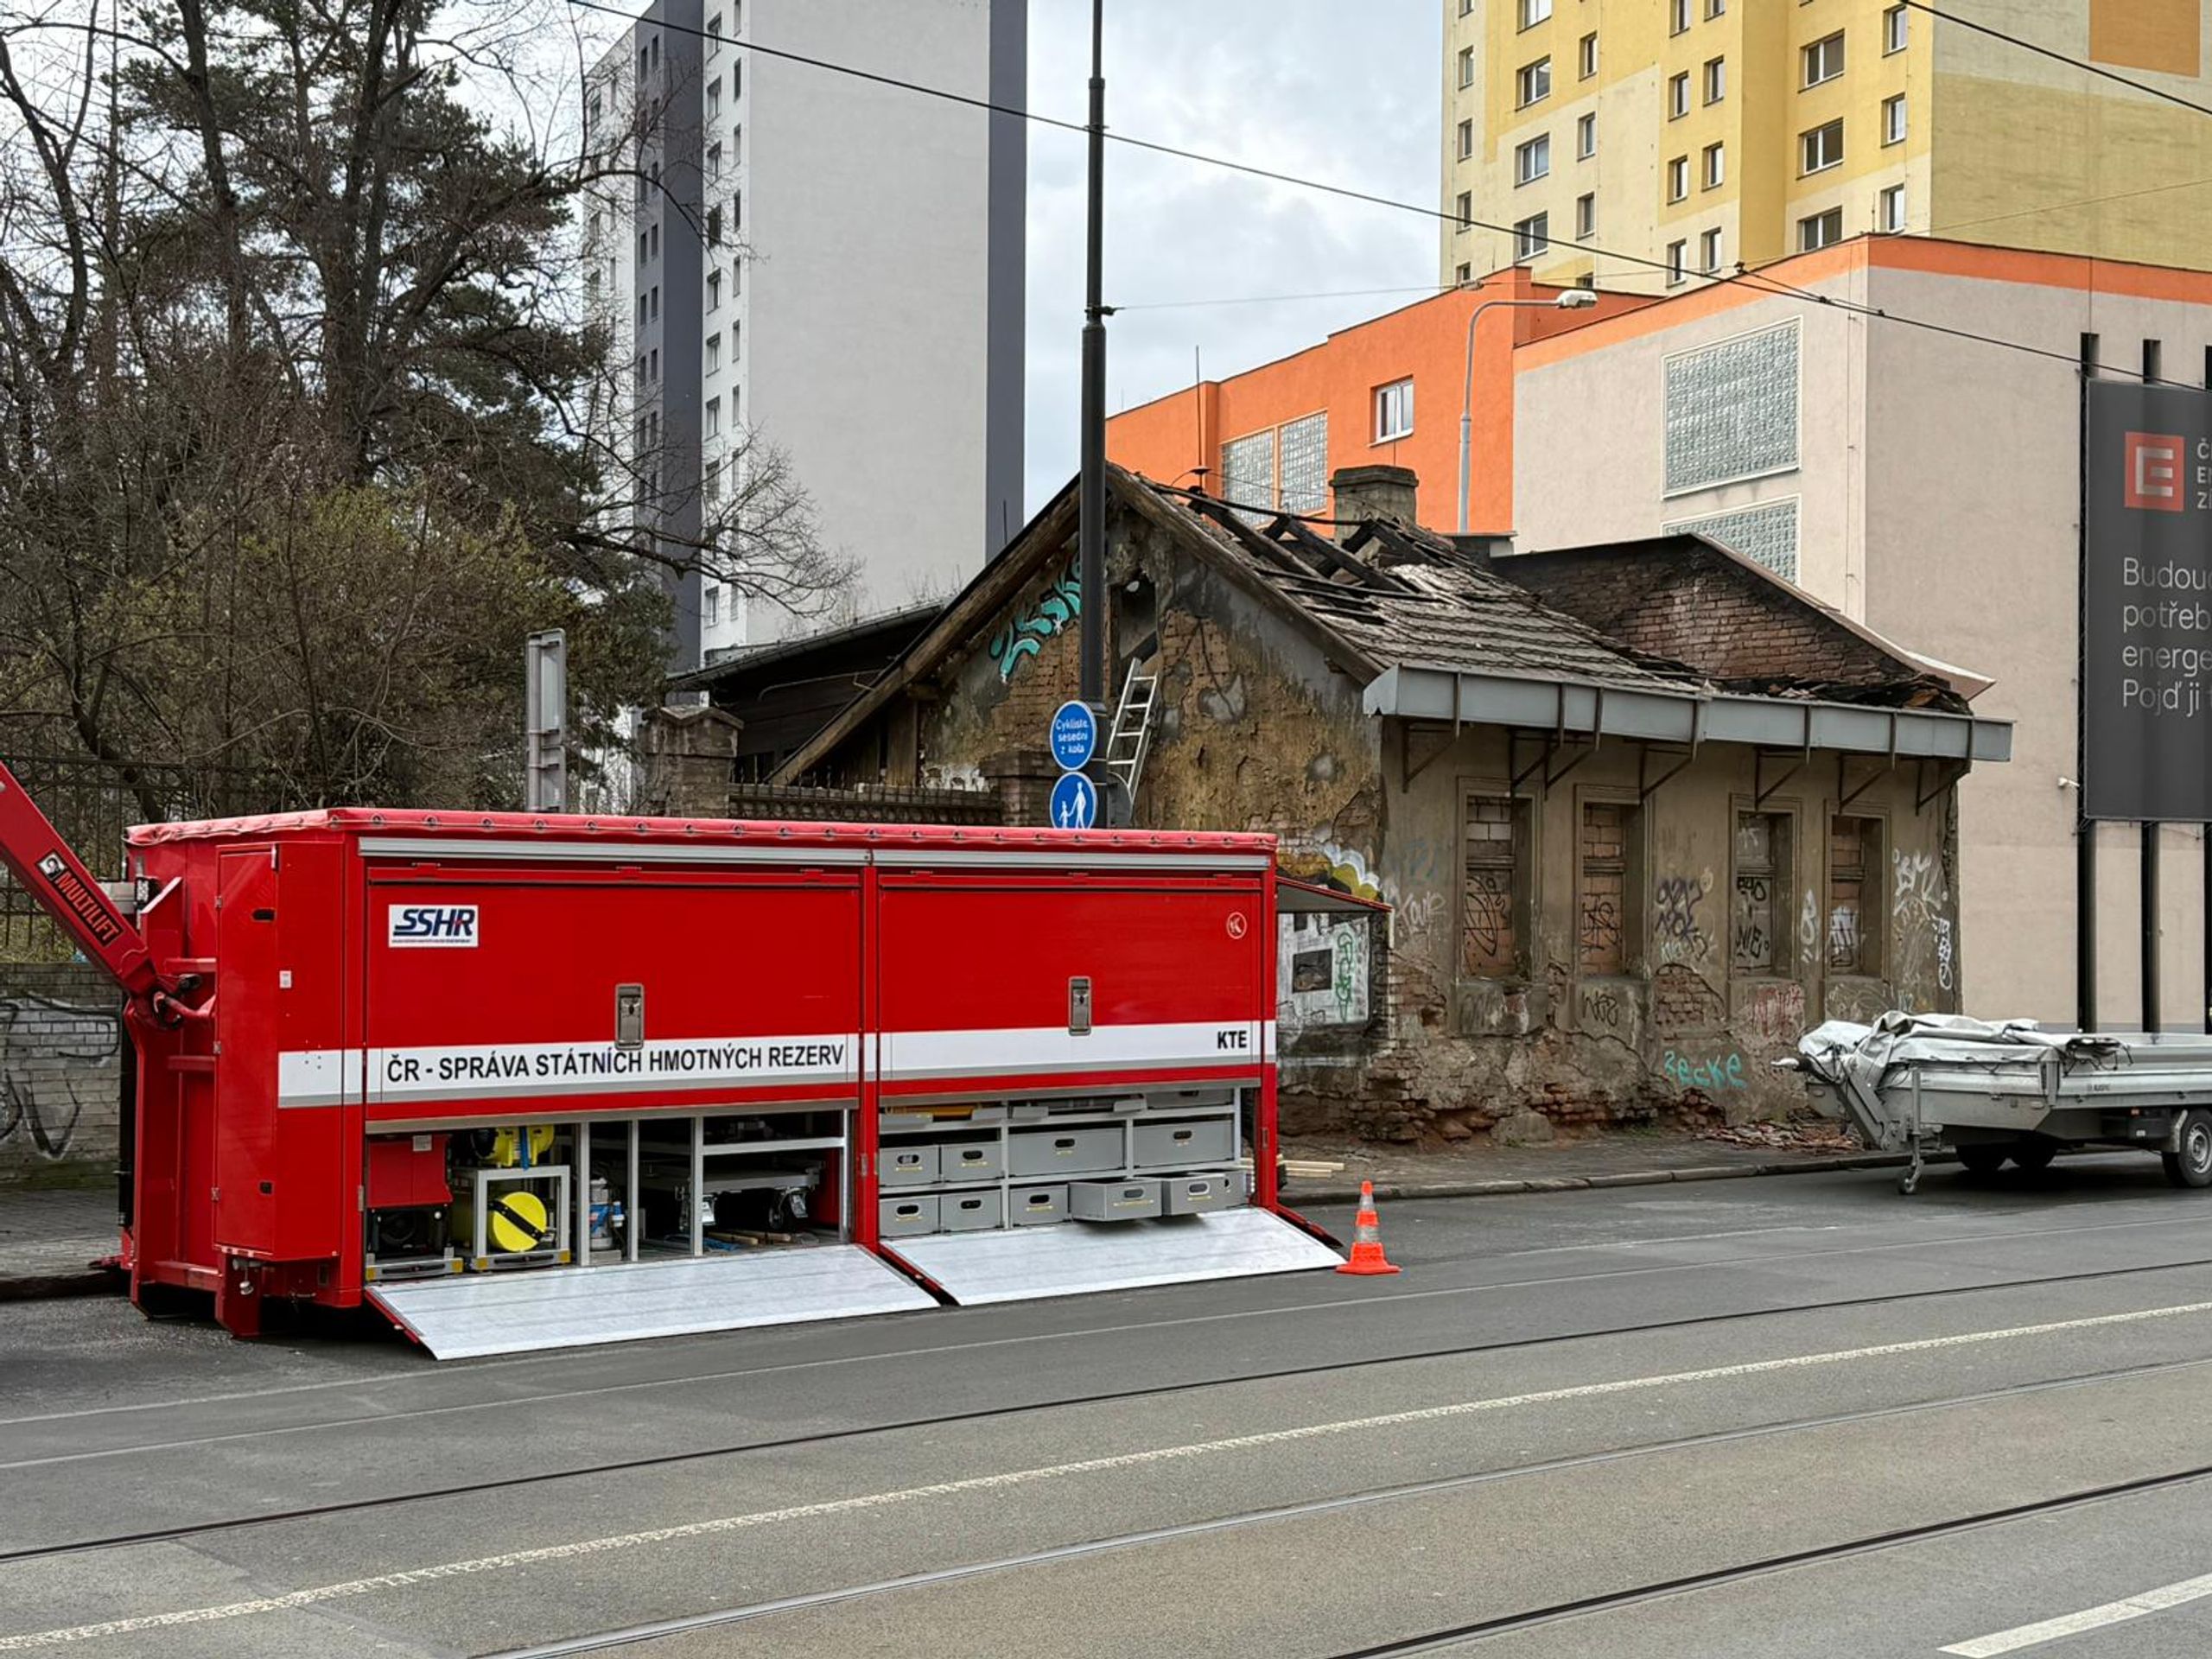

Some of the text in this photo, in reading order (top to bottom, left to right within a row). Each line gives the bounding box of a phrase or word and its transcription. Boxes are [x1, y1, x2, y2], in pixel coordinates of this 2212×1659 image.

[2196, 437, 2212, 460] Č
[2123, 601, 2212, 633] potřeb
[2122, 645, 2212, 677] energe
[2123, 679, 2183, 716] Pojď
[2186, 682, 2200, 717] ji
[54, 870, 119, 941] MULTILIFT
[392, 908, 475, 937] SSHR
[1217, 1031, 1247, 1049] KTE
[387, 1053, 420, 1082] ČR
[439, 1051, 530, 1080] SPRÁVA
[536, 1047, 642, 1077] STÁTNÍCH
[650, 1043, 762, 1071] HMOTNÝCH
[768, 1044, 844, 1067] REZERV
